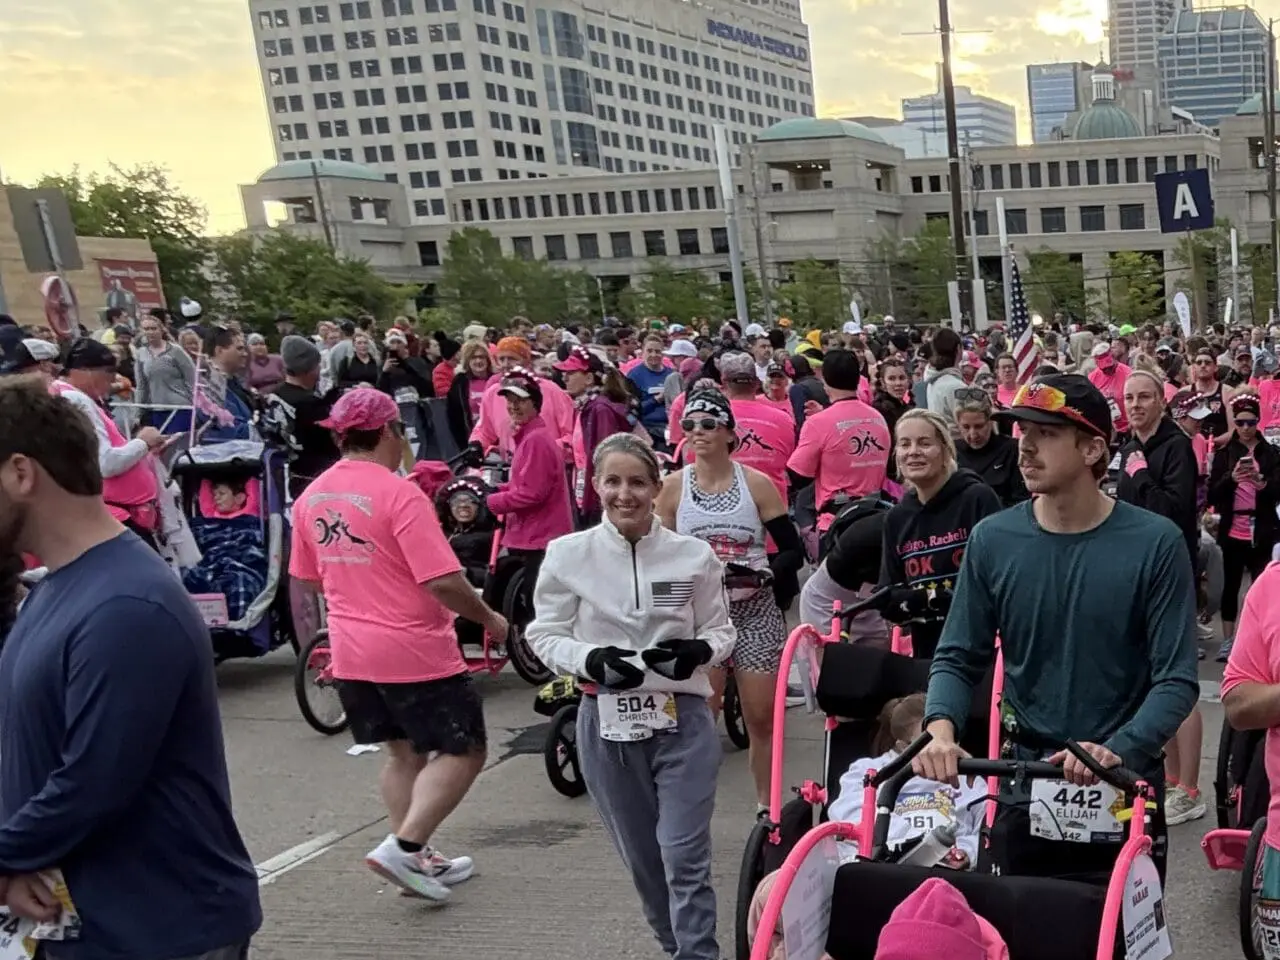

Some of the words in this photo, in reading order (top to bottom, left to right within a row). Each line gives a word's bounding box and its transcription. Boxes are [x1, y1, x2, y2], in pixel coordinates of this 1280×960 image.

[1173, 183, 1199, 219] A
[928, 527, 968, 547] Rachel!
[617, 694, 657, 713] 504
[618, 712, 658, 722] CHRISTI
[1053, 788, 1102, 809] 442
[1056, 808, 1099, 820] ELIJAH
